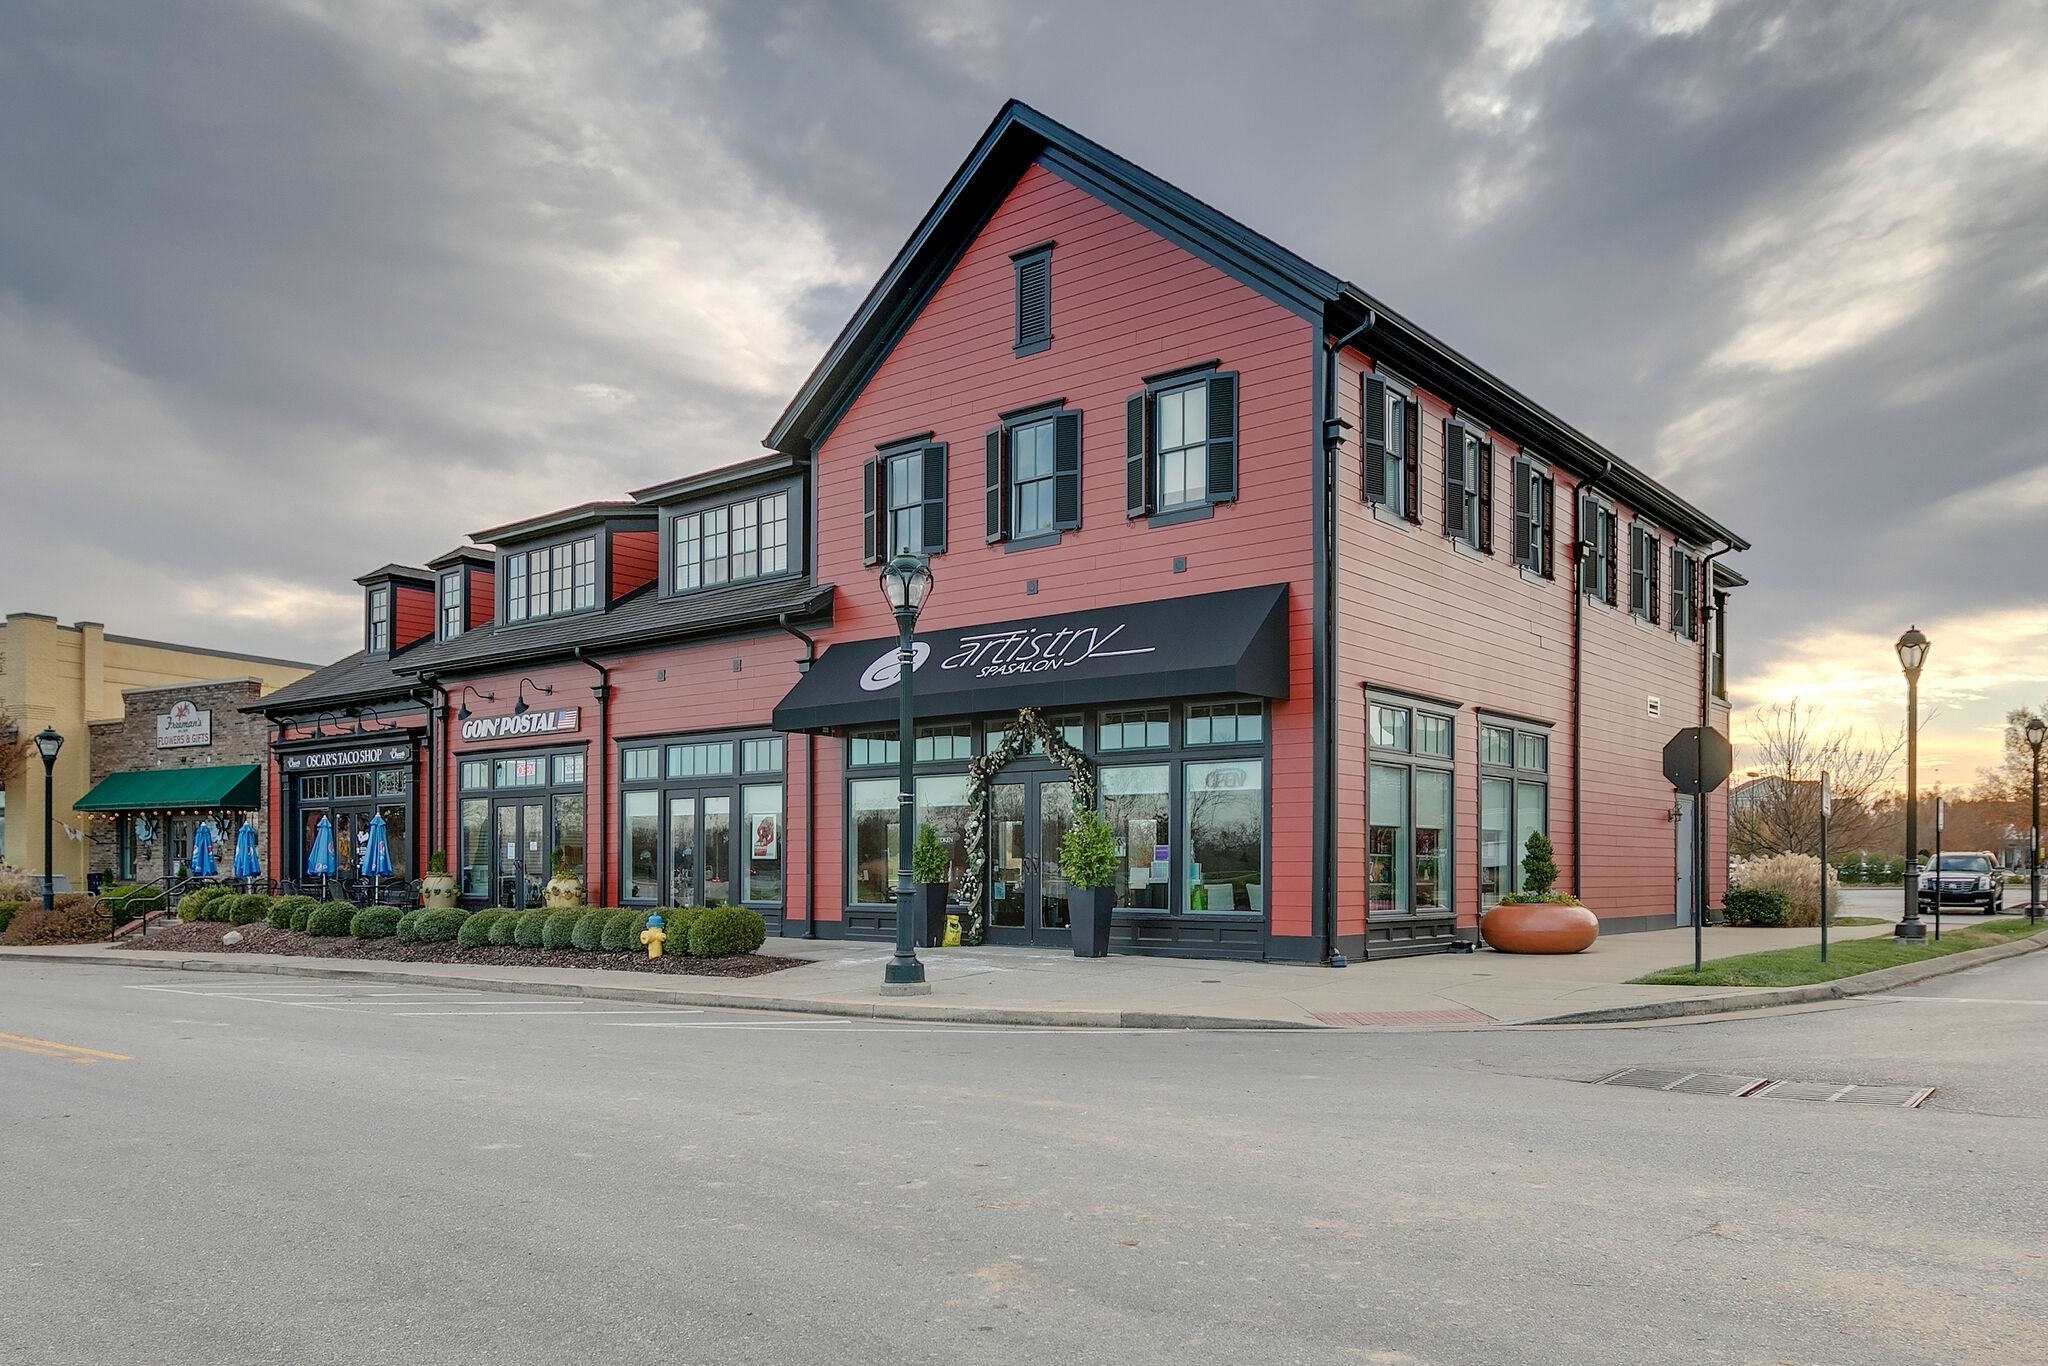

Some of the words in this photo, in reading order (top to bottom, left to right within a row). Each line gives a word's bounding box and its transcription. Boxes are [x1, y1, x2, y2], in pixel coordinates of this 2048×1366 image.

[941, 624, 1155, 670] artistry
[499, 711, 557, 736] POSTAL
[158, 735, 185, 746] FLOWERS
[191, 733, 209, 743] GIFTS
[306, 753, 337, 767] OSCAR'S
[337, 749, 360, 764] TACO
[360, 748, 382, 763] SHOP
[1207, 771, 1244, 787] OPEN
